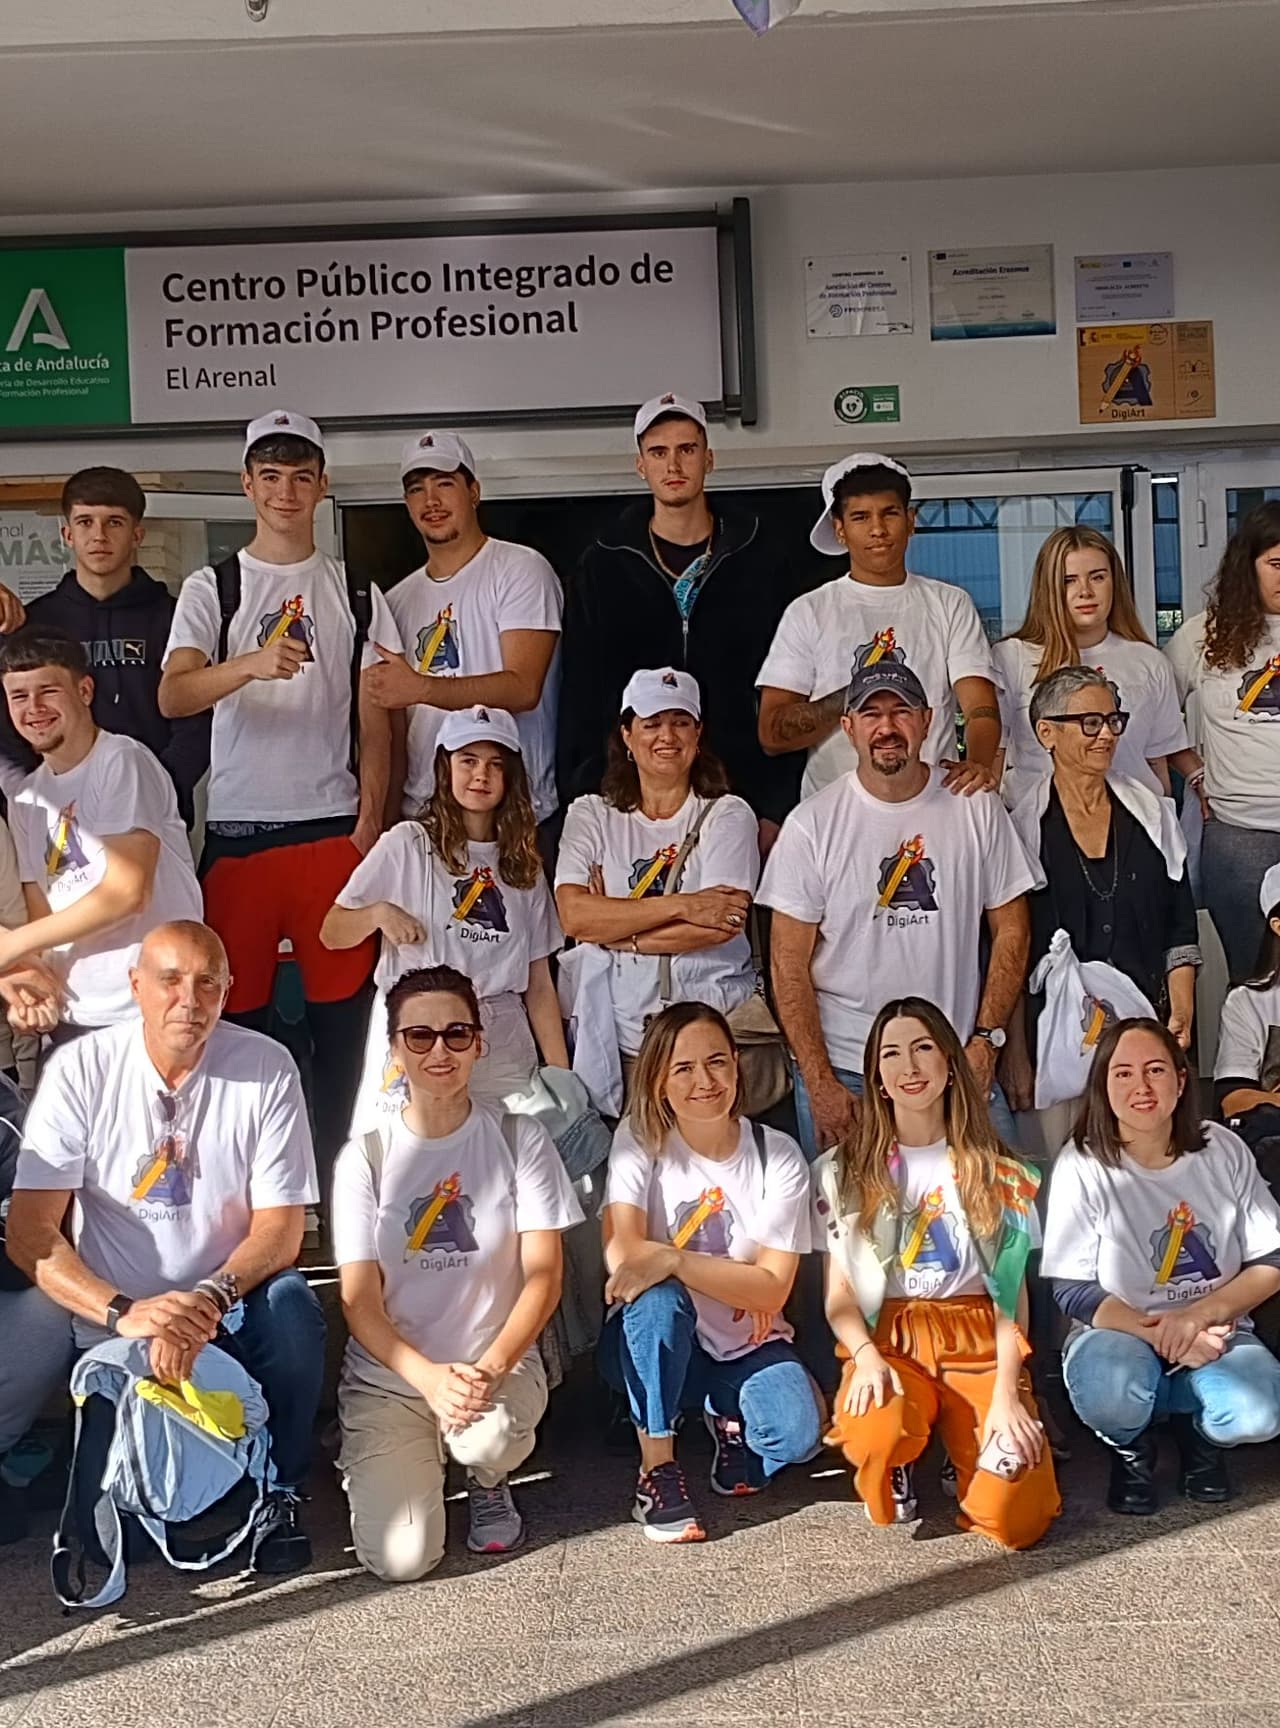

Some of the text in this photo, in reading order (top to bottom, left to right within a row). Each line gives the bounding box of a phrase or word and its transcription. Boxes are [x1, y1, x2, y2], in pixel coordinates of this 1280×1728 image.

[162, 253, 675, 304] Centro Público Integrado de
[164, 302, 579, 348] Formación Profesional
[14, 357, 34, 371] de
[36, 352, 110, 371] Andalucía
[166, 364, 277, 390] El Arenal
[1111, 408, 1145, 419] DigiArt
[887, 914, 929, 929] DigiArt
[460, 927, 501, 943] DigiArt
[139, 1208, 181, 1222] DigiArt
[420, 1256, 469, 1272] DigiArt
[909, 1277, 942, 1293] DigiA
[1167, 1283, 1214, 1301] DigiArt
